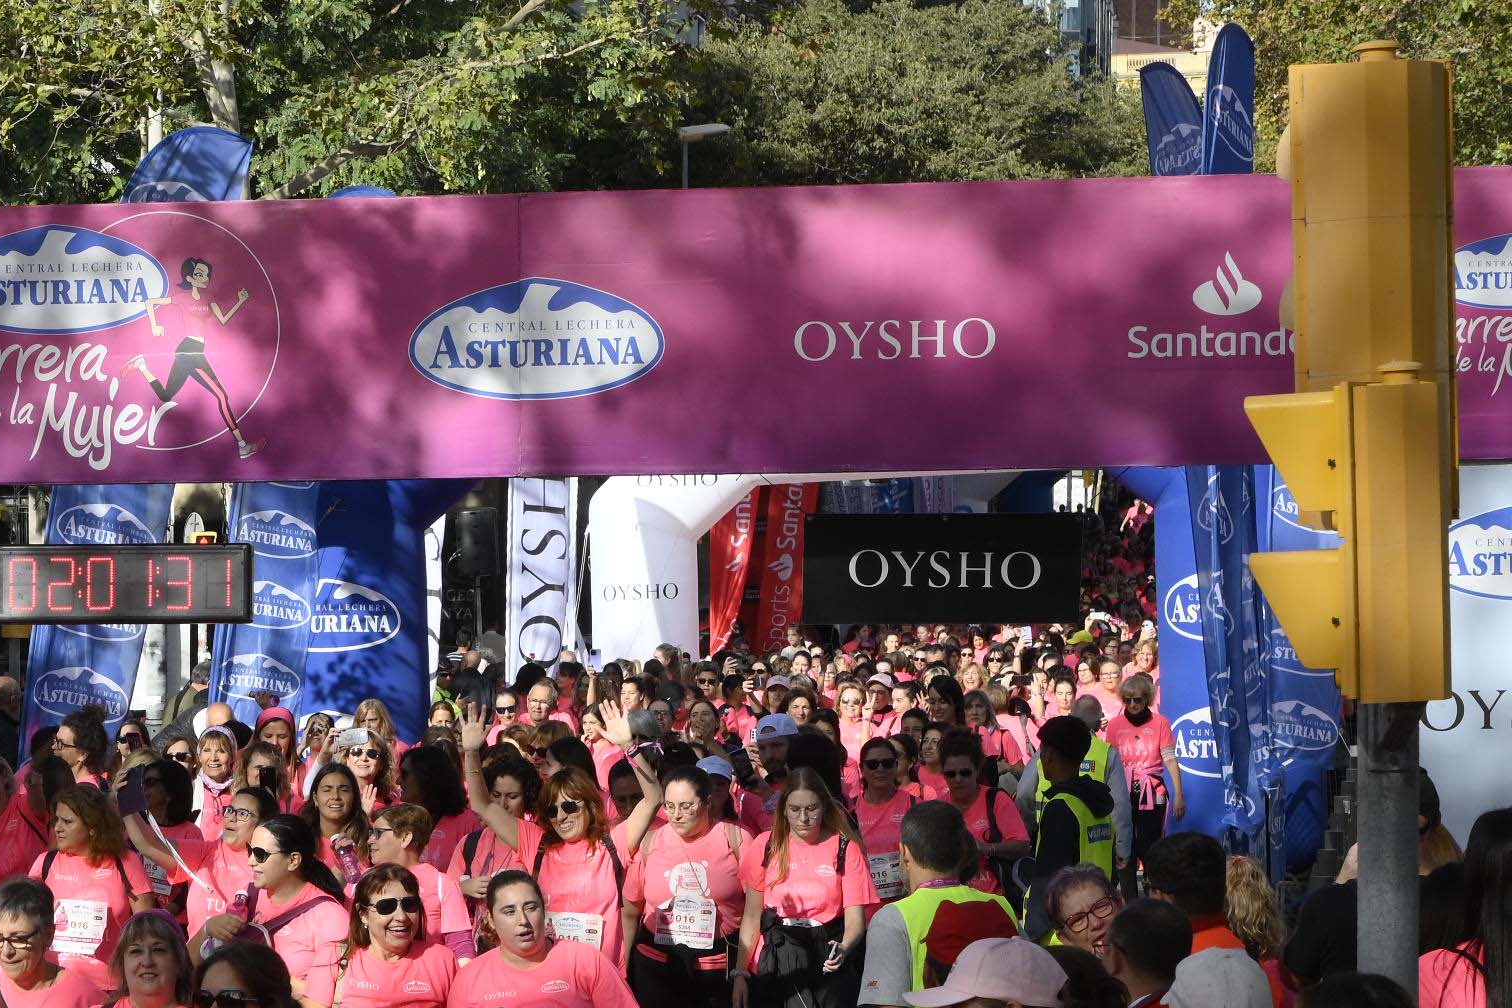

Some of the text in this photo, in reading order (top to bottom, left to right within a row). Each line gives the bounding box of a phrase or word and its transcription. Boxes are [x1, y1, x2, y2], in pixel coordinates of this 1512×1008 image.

[72, 260, 143, 273] LECHERA
[468, 318, 636, 333] CENTRAL LECHERA
[429, 324, 645, 370] ASTURIANA
[794, 317, 996, 361] OYSHO
[1127, 324, 1296, 359] Santand
[1477, 345, 1496, 372] la
[10, 385, 34, 425] la
[29, 376, 178, 471] Mujer
[238, 523, 313, 552] ASTURIANA
[518, 477, 569, 669] OYSH
[848, 549, 1042, 589] OYSHO
[8, 555, 234, 612] 02:01:31
[603, 583, 679, 602] OYSHO
[254, 603, 304, 622] URIANA
[338, 603, 387, 612] LECHERA
[311, 614, 392, 633] URIANA
[207, 898, 226, 912] TU
[70, 921, 88, 930] 016
[675, 914, 695, 924] 016
